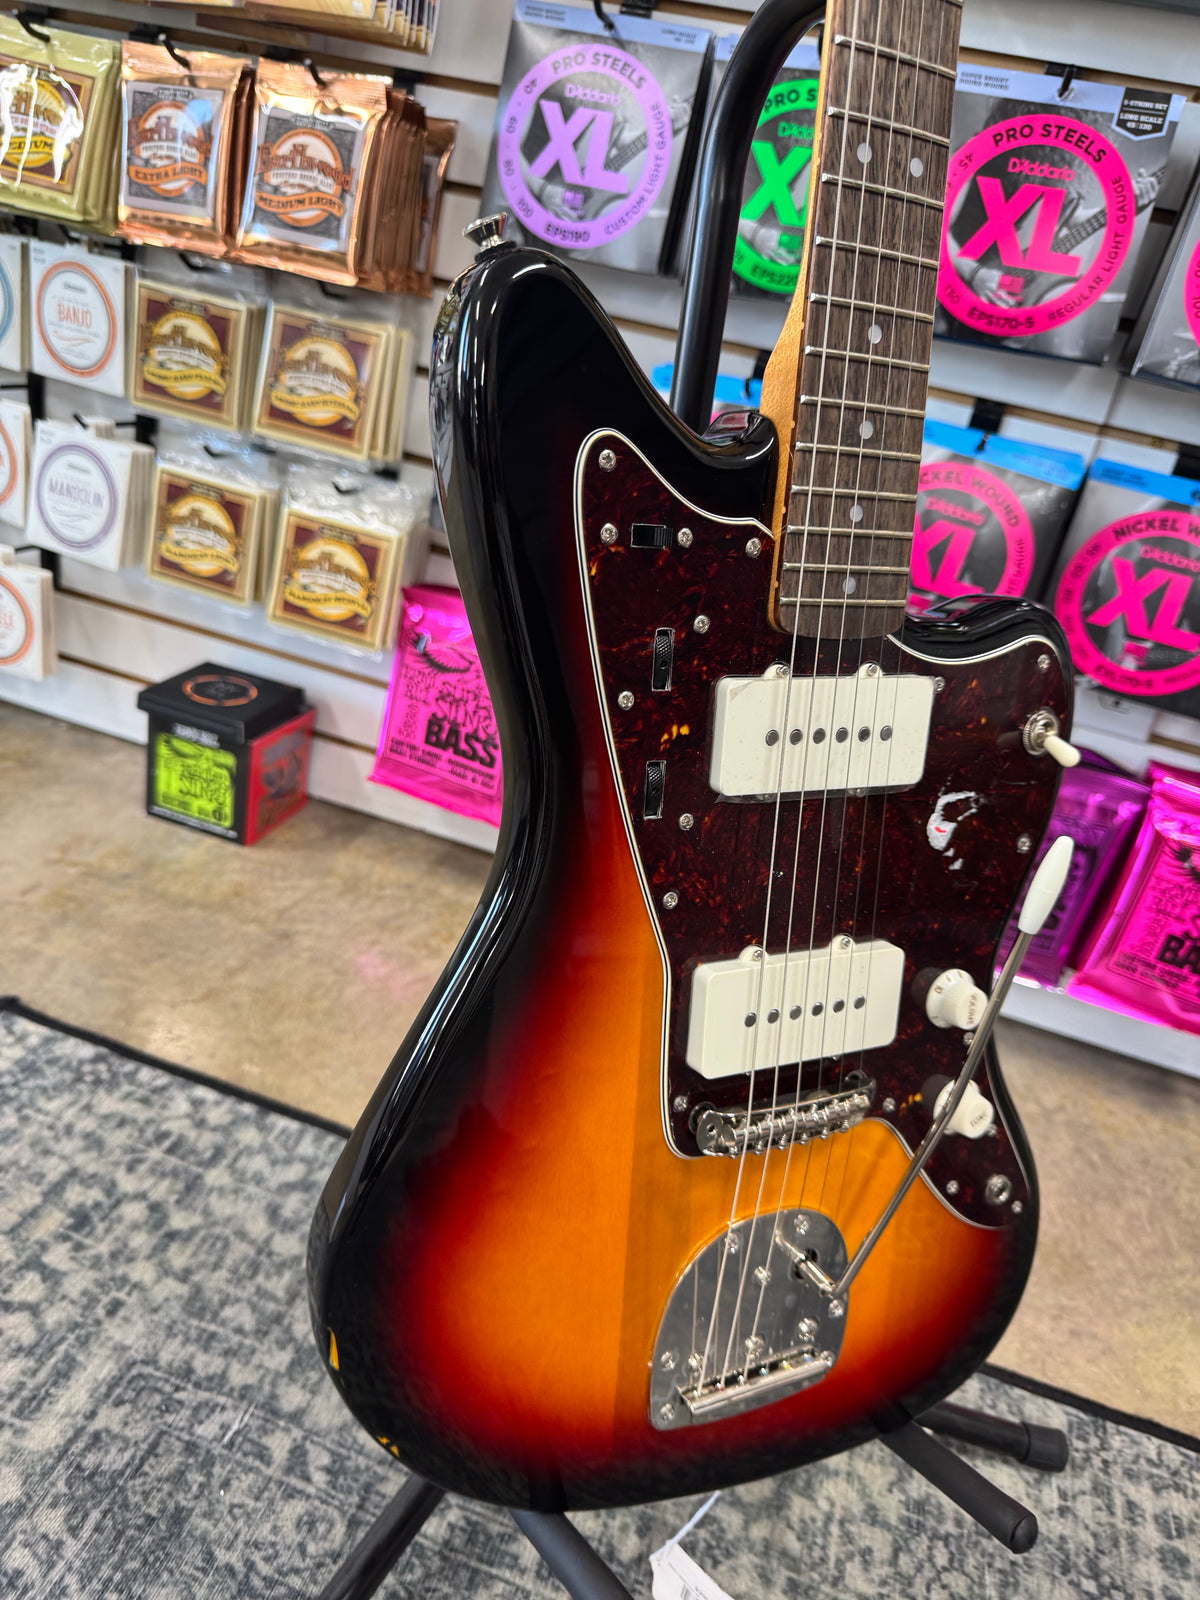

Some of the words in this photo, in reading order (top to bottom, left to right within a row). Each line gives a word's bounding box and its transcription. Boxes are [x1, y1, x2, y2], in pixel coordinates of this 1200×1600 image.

[552, 52, 585, 74] PRO
[592, 52, 647, 89] STEELS
[764, 89, 800, 112] PRO
[527, 99, 631, 194] XL
[992, 124, 1034, 147] PRO
[1041, 123, 1107, 164] STEELS
[740, 140, 813, 227] X
[1007, 157, 1076, 182] D'Addario
[1111, 174, 1129, 225] GAUGE
[956, 176, 1082, 278] XL
[1102, 232, 1126, 273] LIGHT
[57, 302, 92, 329] BANJO
[1047, 275, 1104, 322] REGULAR
[49, 477, 104, 510] MANDOLIN
[919, 470, 962, 485] CKEL
[972, 478, 1020, 528] WOUND
[1113, 518, 1179, 540] NICKEL
[1085, 556, 1200, 654] XL
[424, 717, 499, 769] BASS
[1157, 933, 1200, 976] BA
